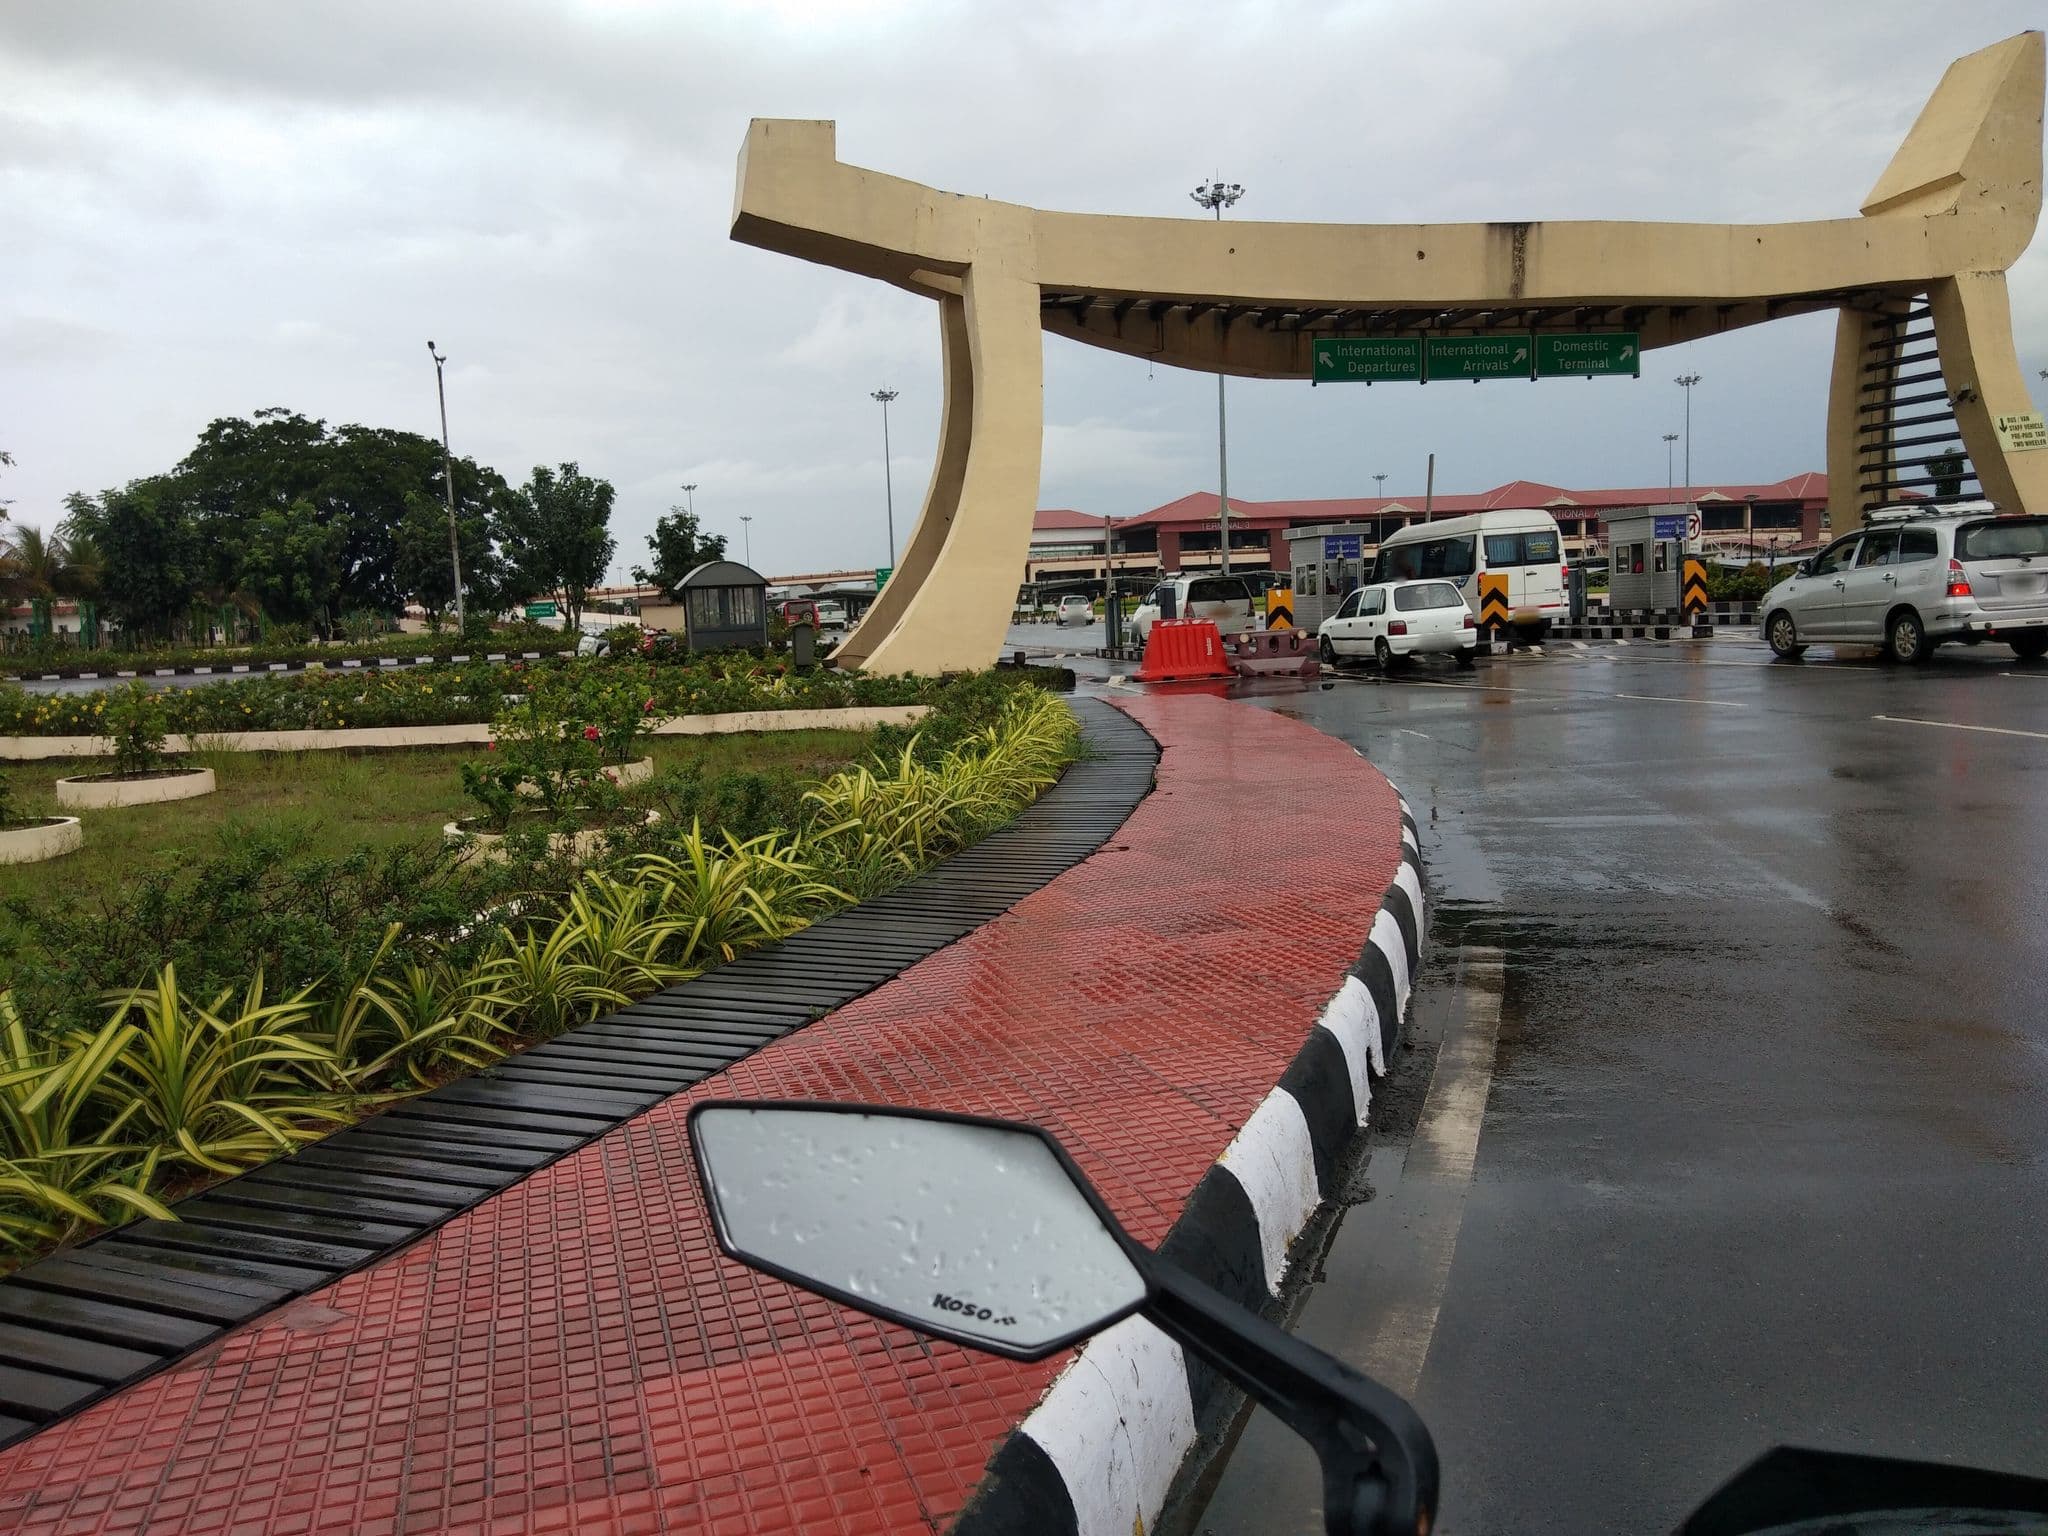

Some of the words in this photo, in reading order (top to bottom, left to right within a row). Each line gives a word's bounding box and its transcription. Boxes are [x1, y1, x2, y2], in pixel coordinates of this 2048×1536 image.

[1337, 344, 1416, 357] International
[1431, 343, 1509, 356] International
[1553, 339, 1609, 352] Domestic
[1348, 361, 1416, 374] Departures
[1463, 359, 1509, 372] Arrivals
[1558, 357, 1610, 369] Terminal
[2024, 422, 2044, 430] VEHICLE
[933, 1294, 992, 1320] KOSO
